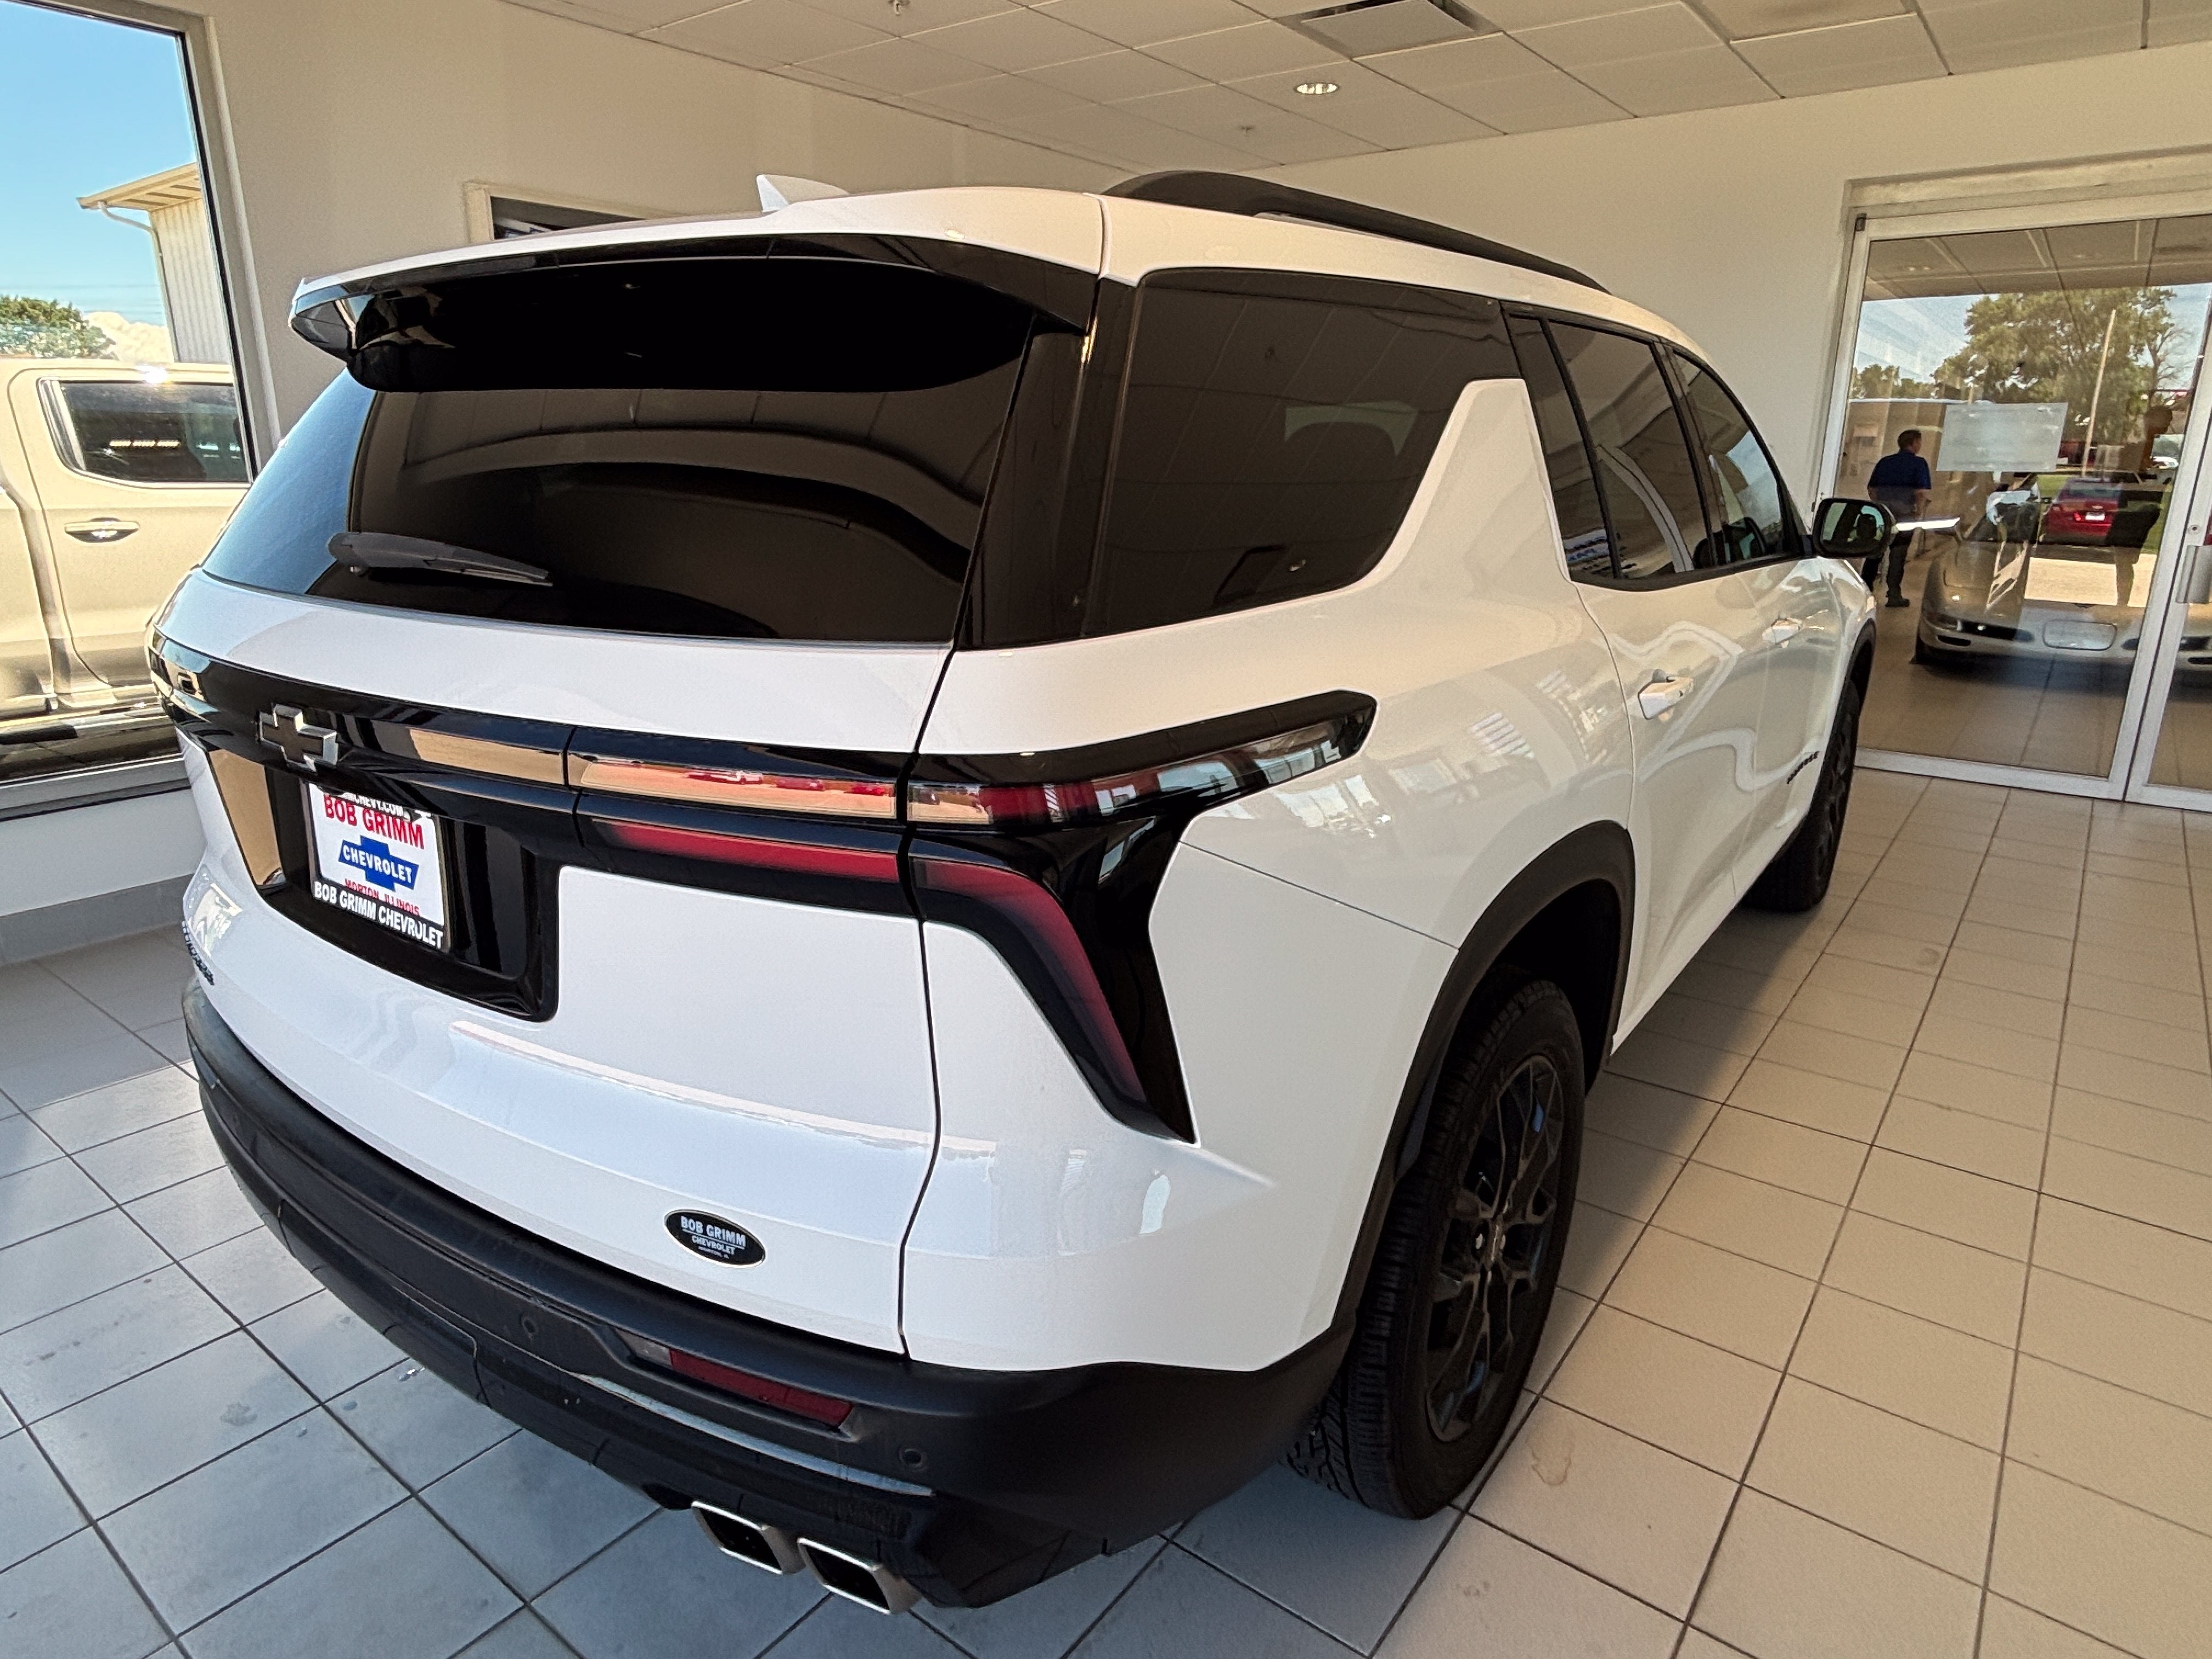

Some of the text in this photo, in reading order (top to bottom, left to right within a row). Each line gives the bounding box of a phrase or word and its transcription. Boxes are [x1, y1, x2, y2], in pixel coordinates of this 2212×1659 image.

[324, 793, 425, 849] BOB GRIMM
[342, 845, 412, 883] CHEVROLET
[314, 881, 443, 949] BOB GRIMM CHEVROLET
[680, 1216, 746, 1247] BOB GRIMM
[691, 1235, 735, 1255] CHEVROLET
